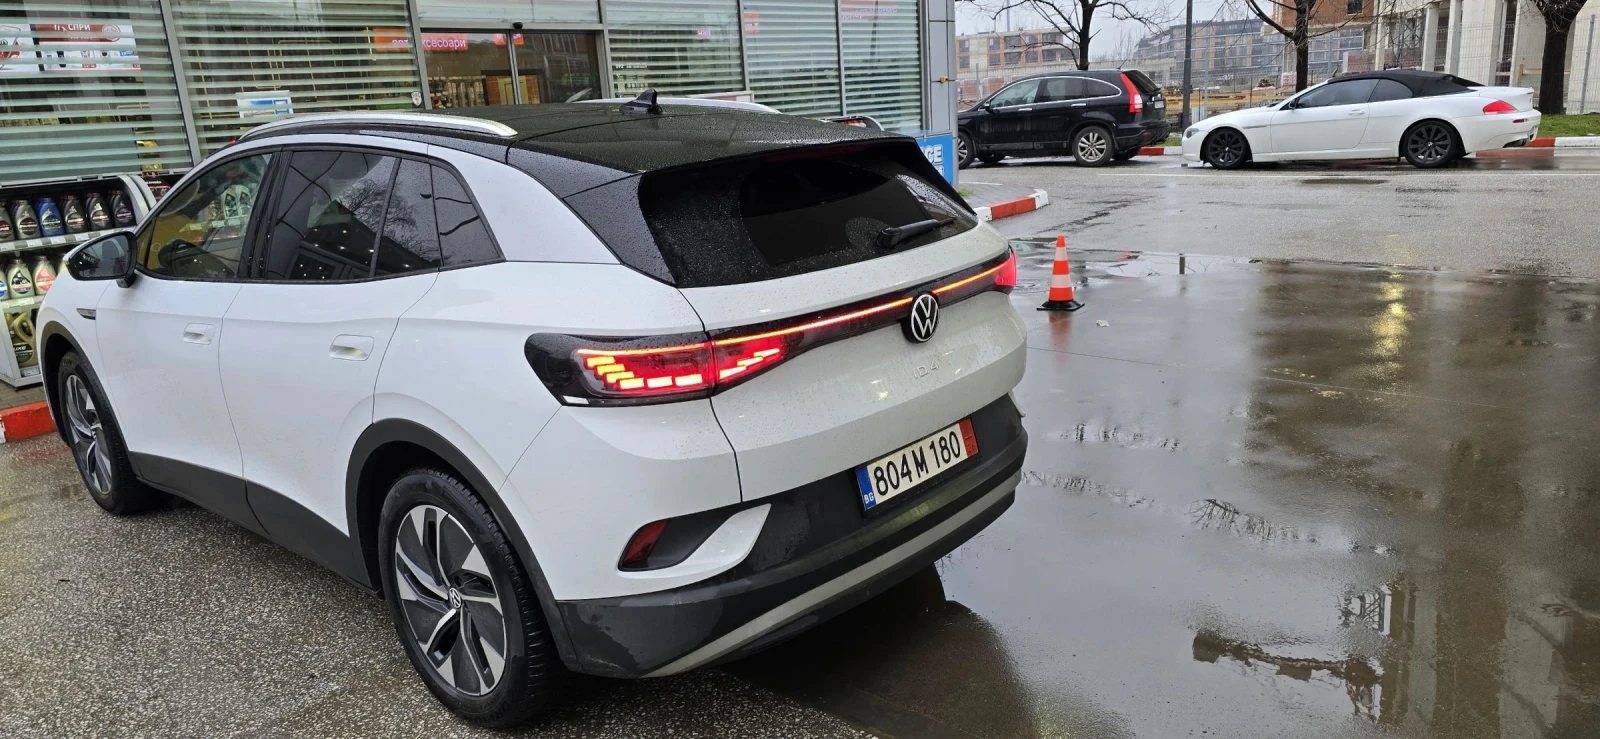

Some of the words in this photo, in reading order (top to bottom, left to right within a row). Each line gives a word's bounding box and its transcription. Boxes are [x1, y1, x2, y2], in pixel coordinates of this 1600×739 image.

[420, 39, 466, 50] ксесоари
[873, 453, 912, 496] 804
[911, 446, 930, 478] M
[929, 430, 961, 469] 180
[863, 491, 875, 504] BG
